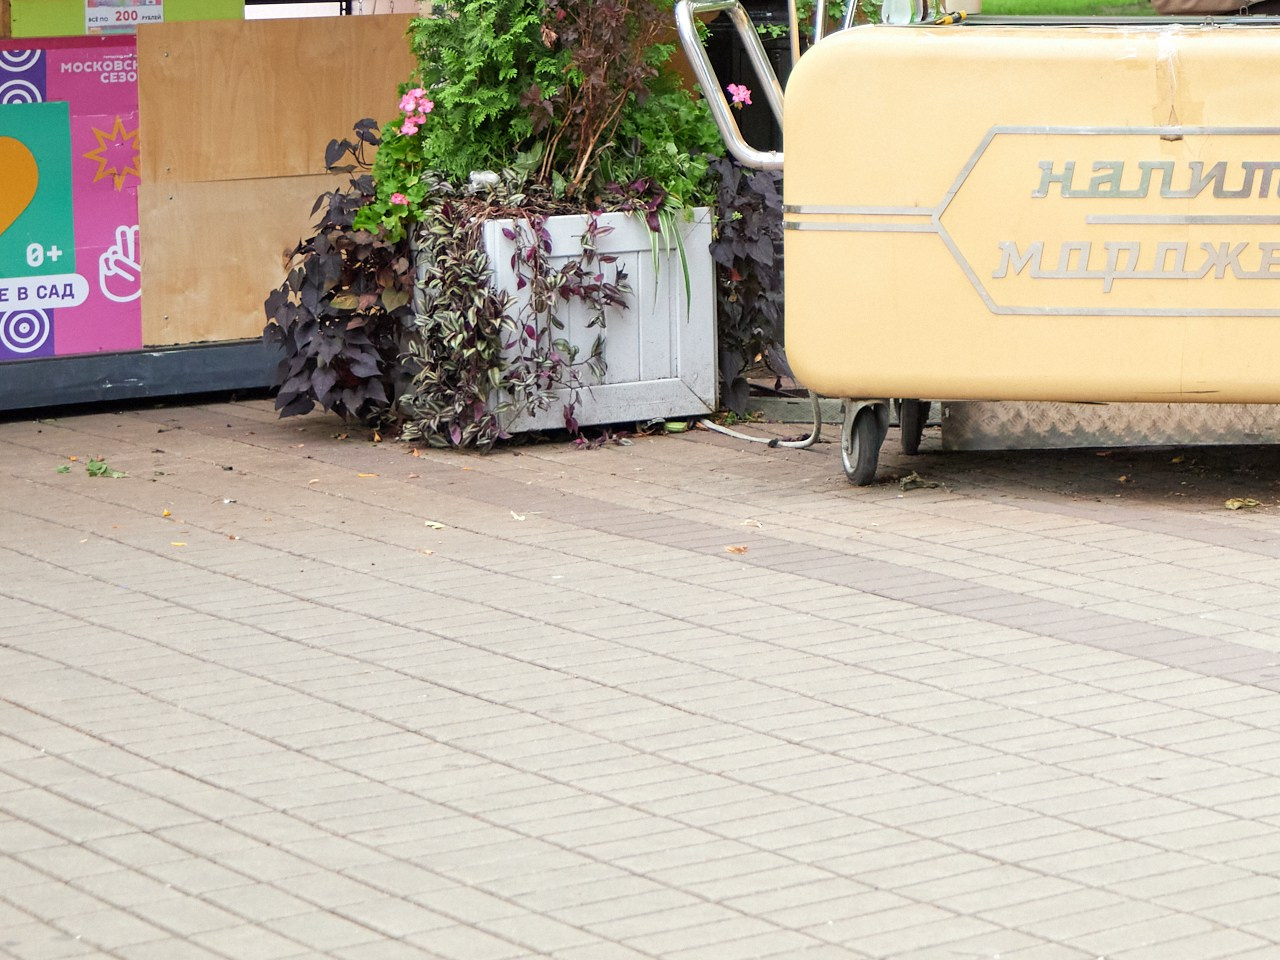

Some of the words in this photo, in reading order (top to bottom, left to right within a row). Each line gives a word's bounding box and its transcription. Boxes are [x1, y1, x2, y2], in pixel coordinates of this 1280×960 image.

[115, 10, 138, 22] 200
[100, 71, 137, 83] СЕЗО
[26, 242, 63, 268] 0+
[17, 286, 29, 301] В
[36, 283, 75, 300] САД
